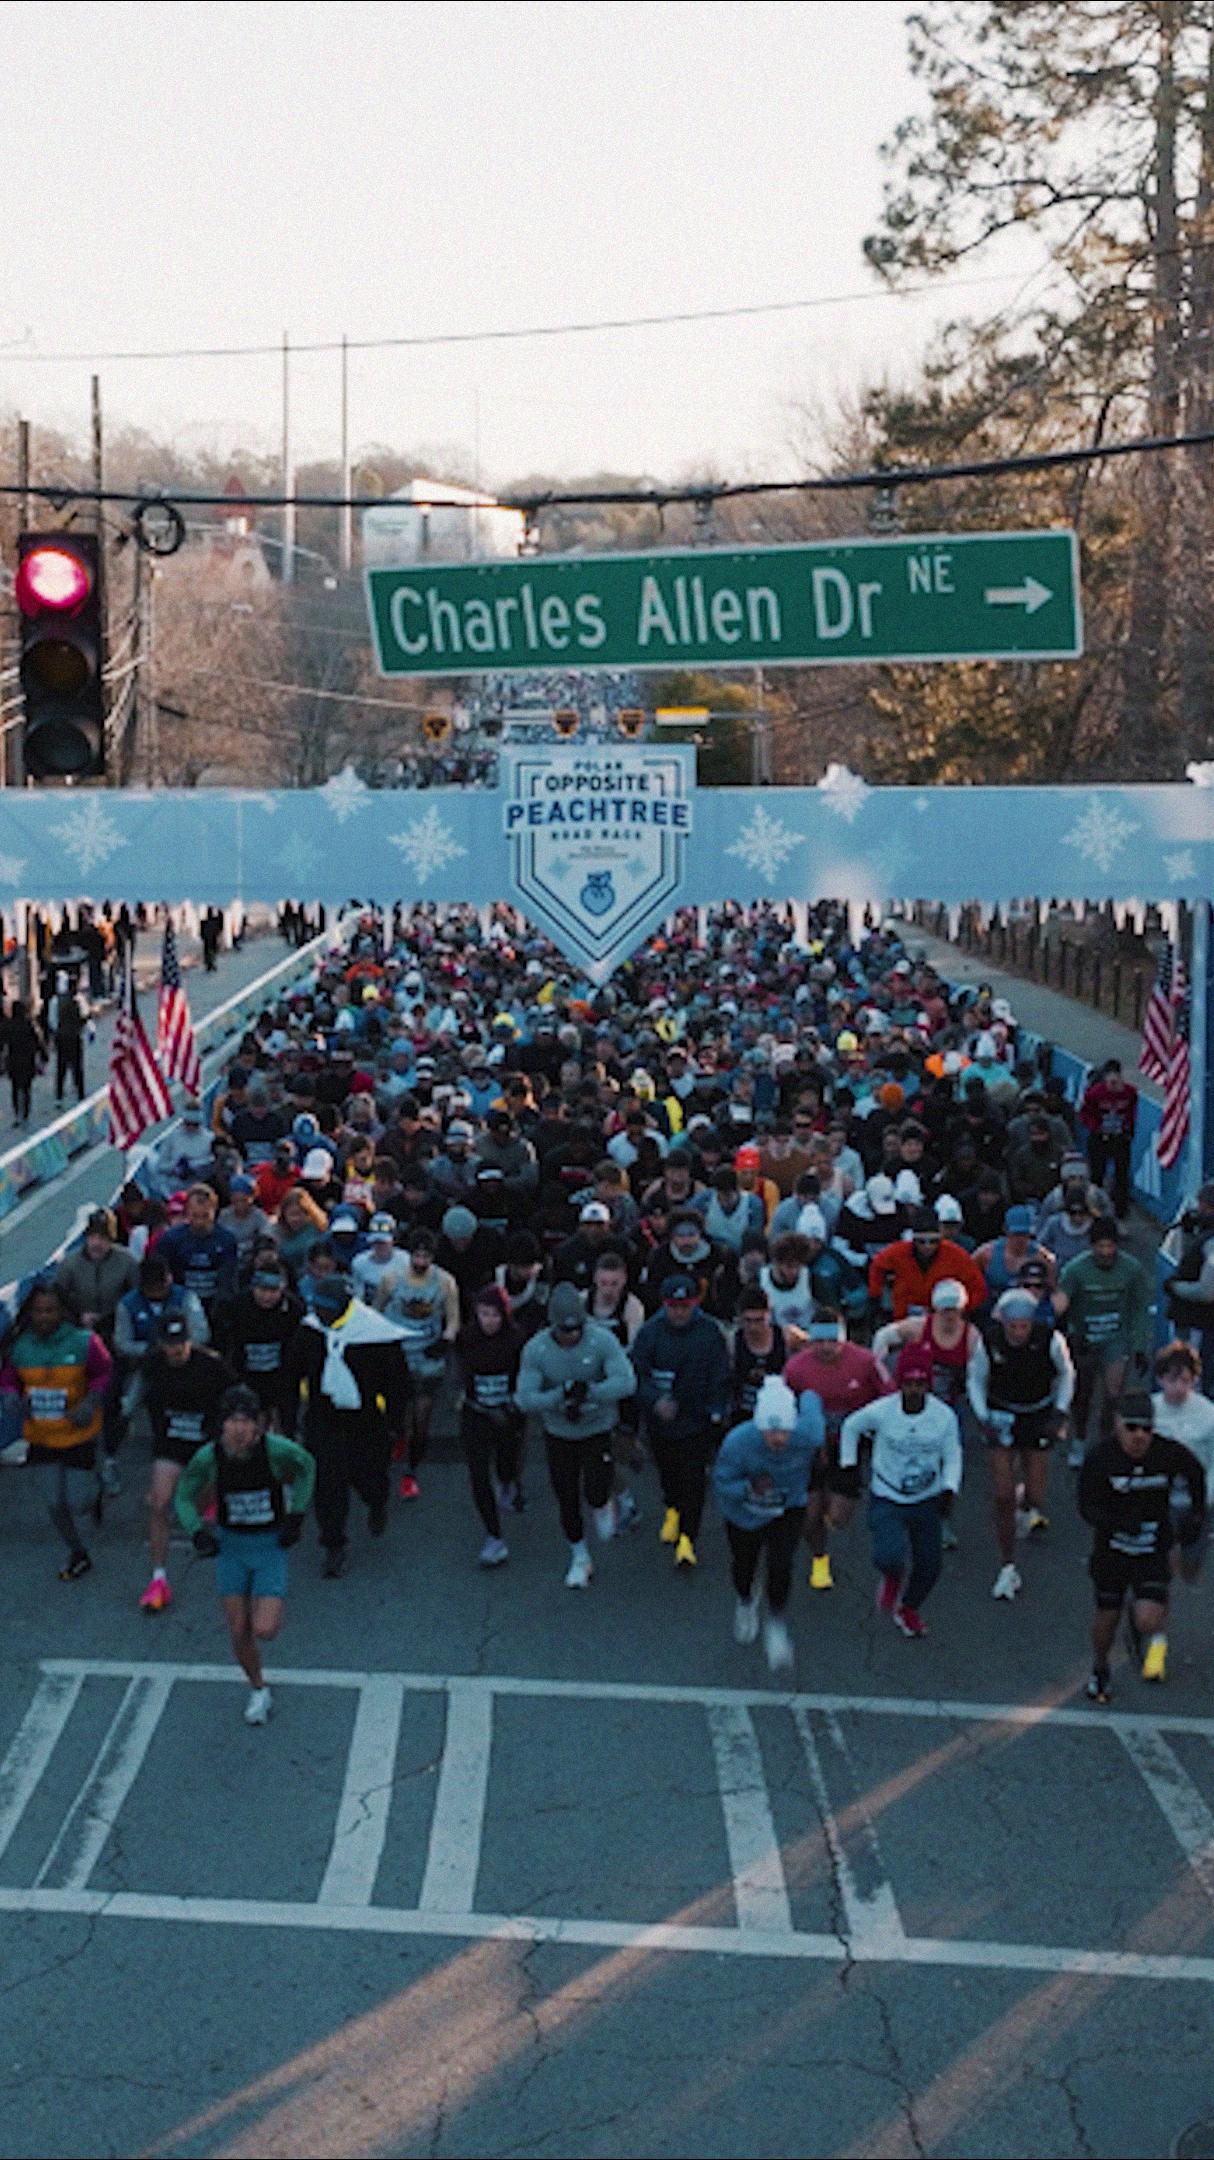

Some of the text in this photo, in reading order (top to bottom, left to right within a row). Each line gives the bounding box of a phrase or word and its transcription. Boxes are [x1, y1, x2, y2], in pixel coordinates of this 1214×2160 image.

[389, 554, 955, 655] Charles Allen Dr NE
[545, 775, 650, 792] OPPOSITE
[507, 798, 690, 829] PEACHTREE
